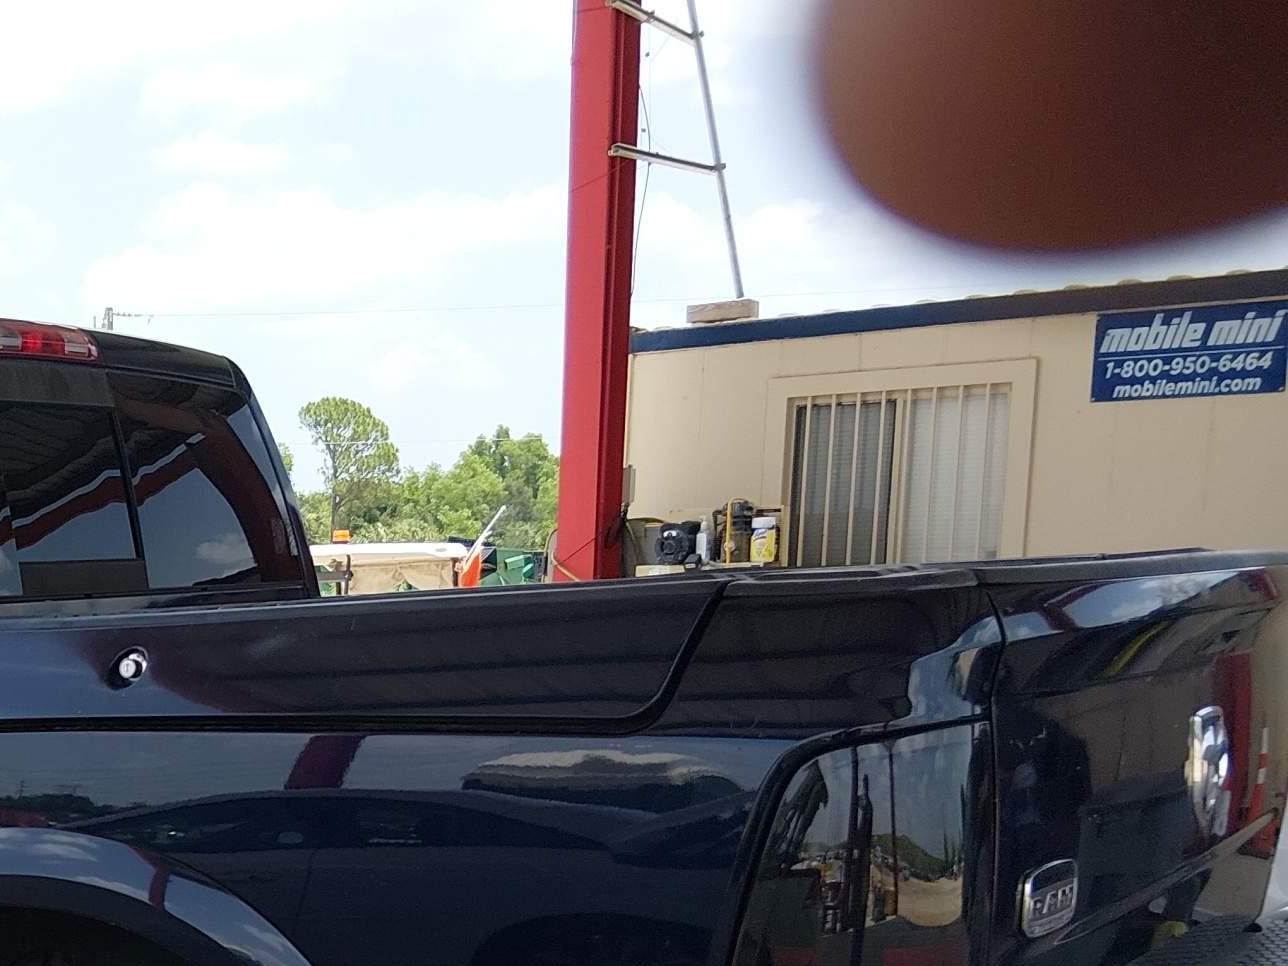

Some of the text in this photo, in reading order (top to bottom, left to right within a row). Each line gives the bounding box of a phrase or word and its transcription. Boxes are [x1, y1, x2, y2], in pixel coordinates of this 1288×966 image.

[1099, 308, 1288, 352] mobile mini
[1105, 351, 1273, 379] 1-800-950-6464
[1112, 376, 1261, 398] mobilemini.com
